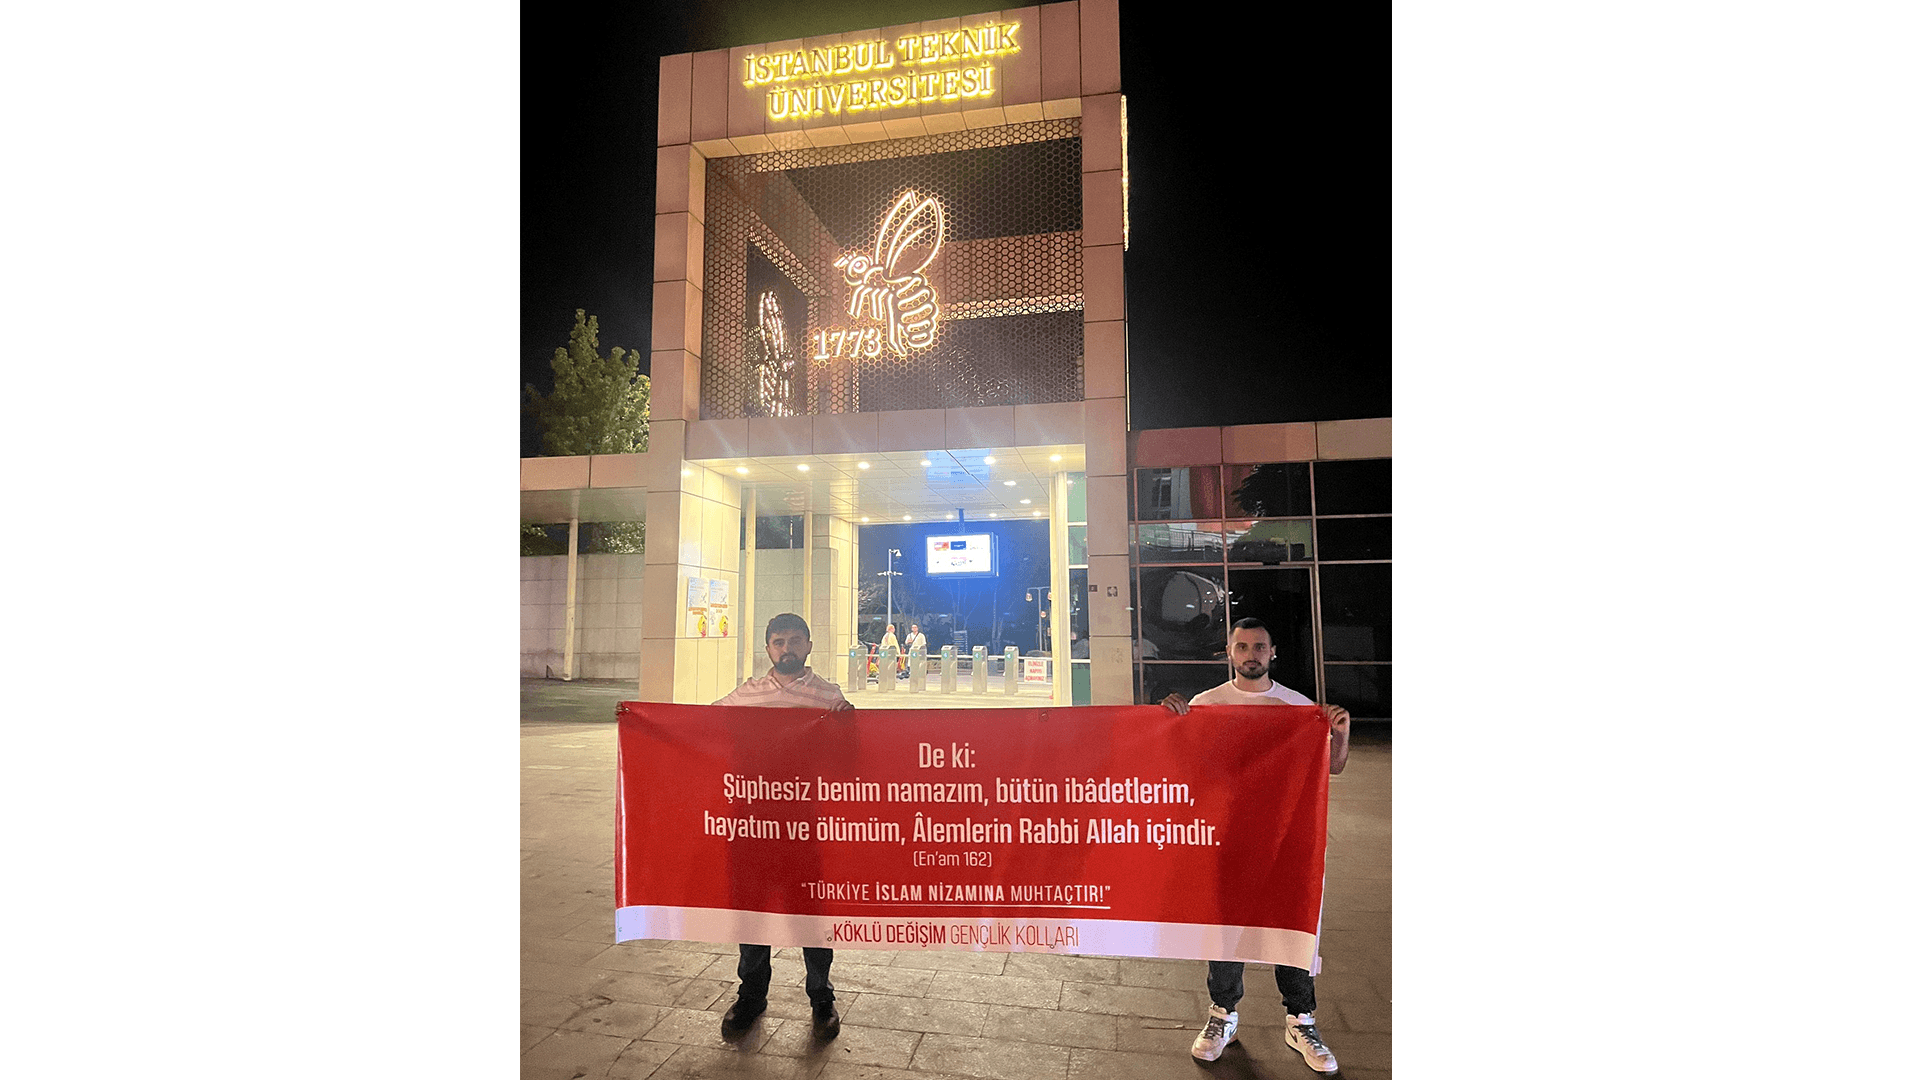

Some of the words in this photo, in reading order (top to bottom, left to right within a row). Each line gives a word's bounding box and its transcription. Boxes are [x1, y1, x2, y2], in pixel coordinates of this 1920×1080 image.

[744, 41, 893, 85] İSTANBUL
[898, 20, 1021, 62] TEKNİK
[768, 62, 995, 118] ÜNİVERSİTESİ
[813, 327, 881, 359] 1773
[919, 743, 945, 768] De
[952, 743, 976, 768] ki:
[723, 773, 811, 804] Şüphesiz
[817, 777, 881, 802] benim
[887, 782, 989, 806] namazım,
[996, 778, 1058, 803] bütün
[1065, 778, 1195, 806] ibâdetlerim,
[704, 810, 780, 841] hayatım
[786, 821, 810, 840] ve
[816, 816, 906, 845] ölümüm,
[912, 812, 1012, 843] Âlemlerin
[1019, 819, 1079, 844] Rabbi
[1086, 819, 1140, 844] Allah
[1146, 819, 1221, 850] içindir.
[964, 851, 992, 867] 162)
[875, 881, 922, 901] İSLAM
[928, 881, 1005, 902] NİZAMINA
[833, 921, 883, 943] KÖKLÜ
[886, 921, 946, 947] DEĞİŞİM
[950, 922, 1011, 949] GENÇLİK
[1015, 926, 1079, 947] KOLLARI
